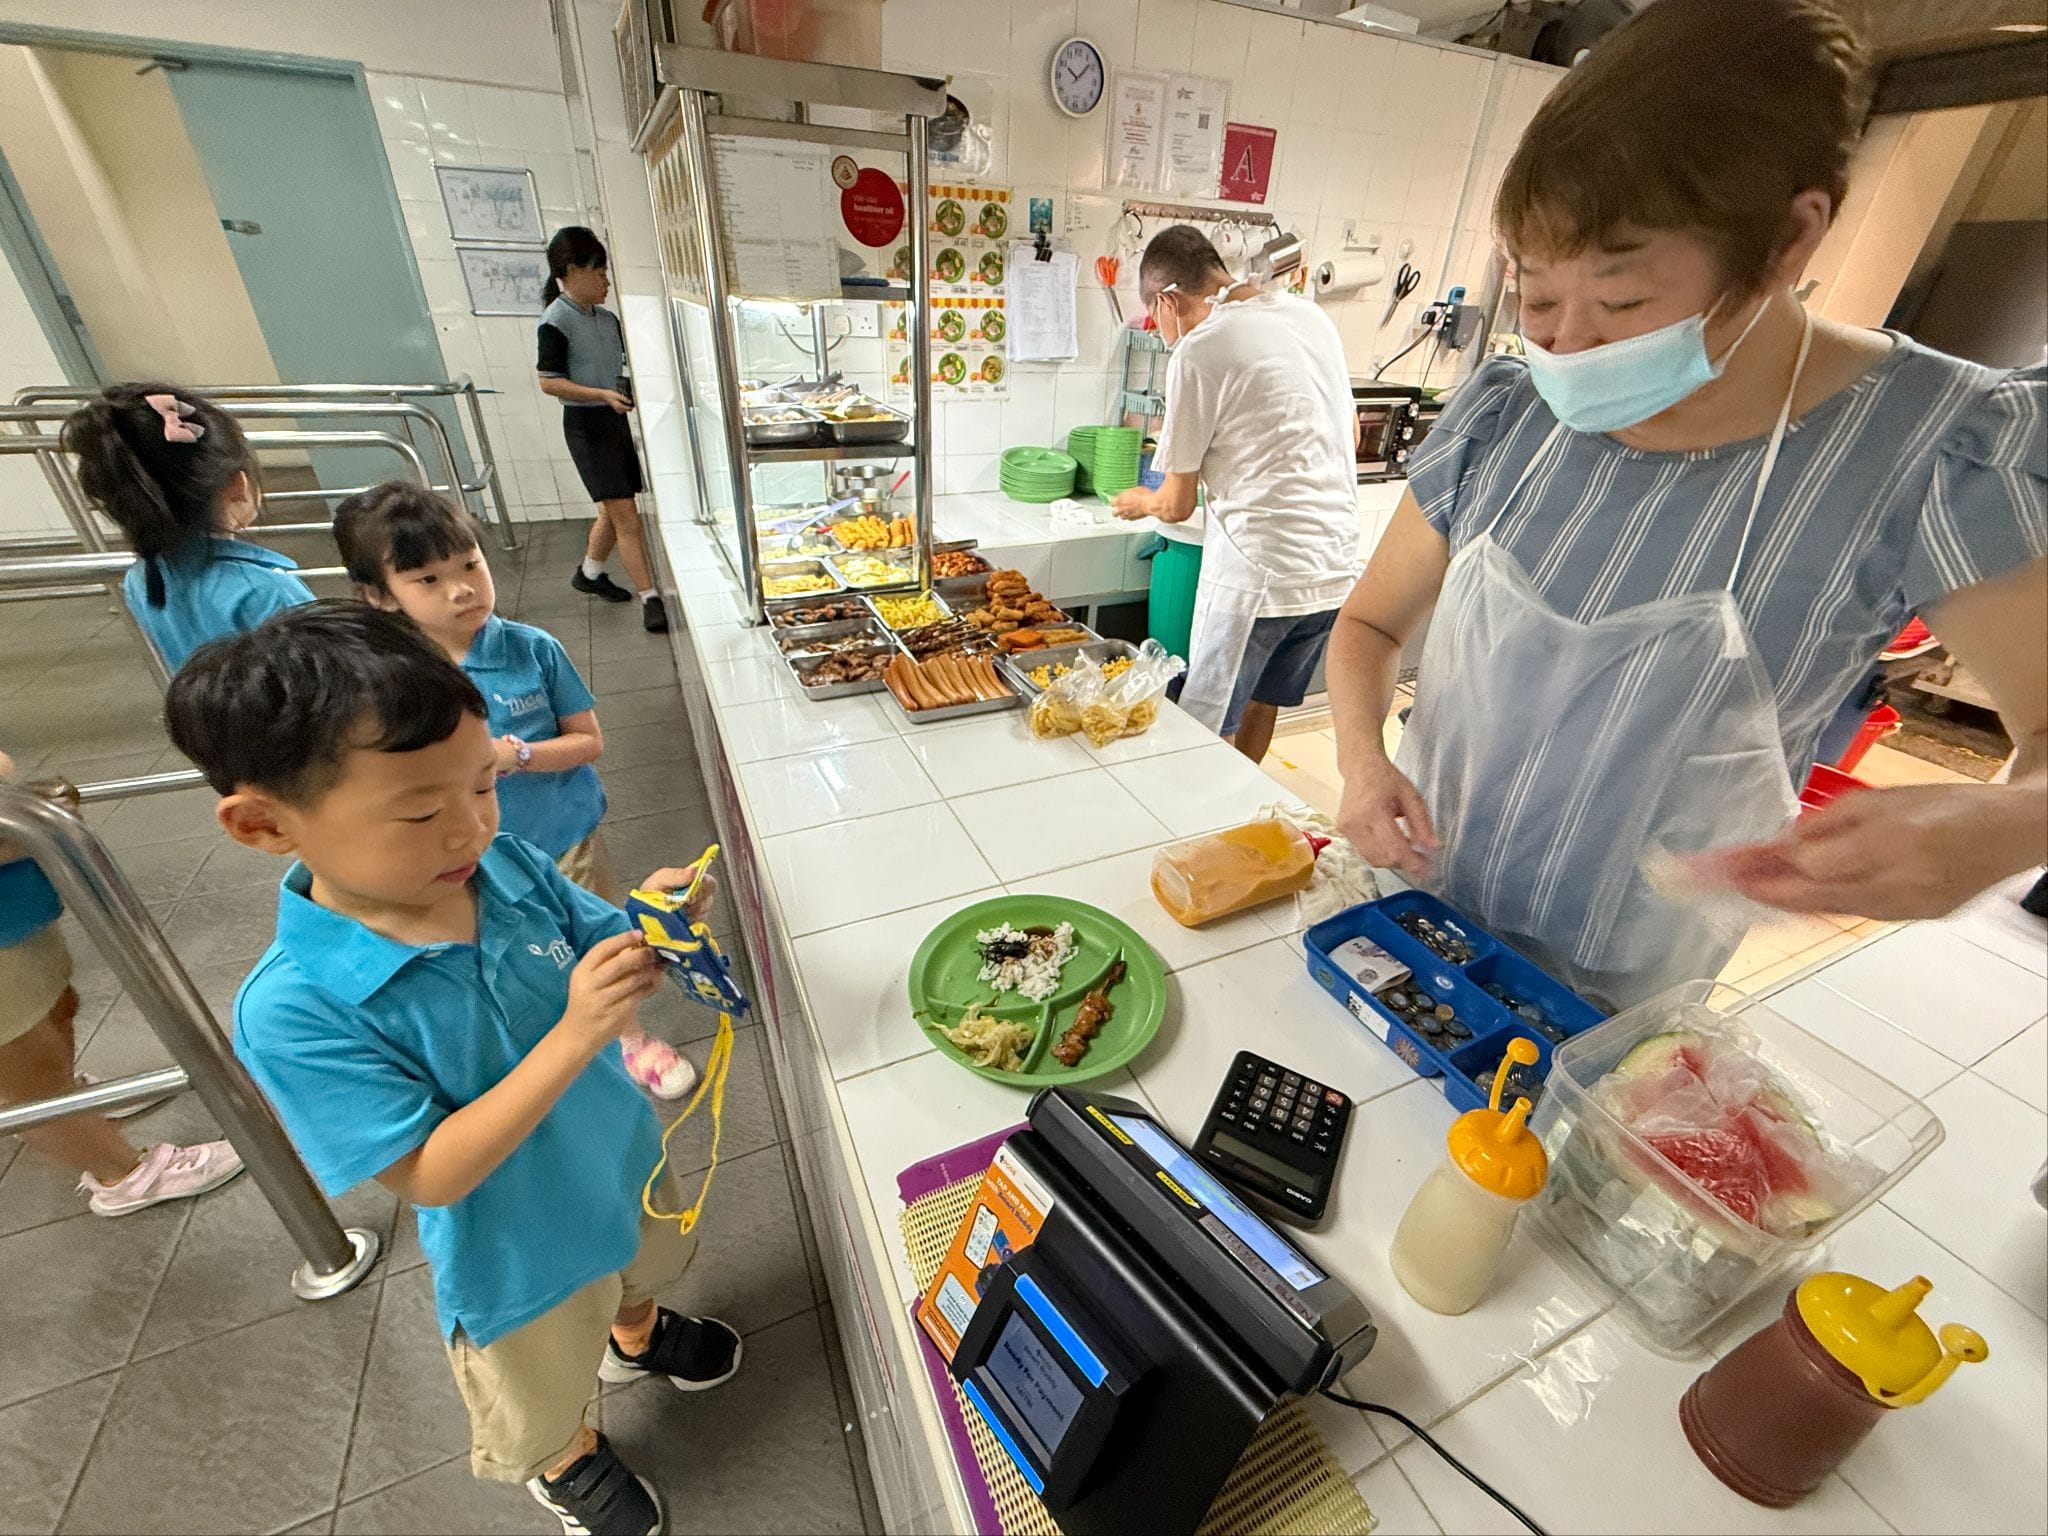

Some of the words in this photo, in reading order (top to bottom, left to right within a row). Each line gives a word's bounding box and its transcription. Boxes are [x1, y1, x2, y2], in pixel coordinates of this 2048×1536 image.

[1230, 143, 1256, 184] A
[853, 201, 884, 214] healthier
[1263, 1076, 1271, 1085] 3
[1259, 1087, 1268, 1096] 6
[1284, 1086, 1293, 1095] 2
[1309, 1084, 1317, 1093] 0
[1254, 1099, 1262, 1108] 9
[1280, 1097, 1289, 1107] 5
[1306, 1095, 1312, 1104] 1
[1275, 1108, 1284, 1118] 8
[1302, 1106, 1310, 1115] 4
[1221, 1111, 1235, 1120] OFF
[1297, 1119, 1305, 1128] 7
[997, 1177, 1008, 1191] TAP
[1007, 1190, 1020, 1206] AND
[1019, 1203, 1031, 1218] PAY
[1286, 1187, 1313, 1204] CASIO
[998, 1191, 1015, 1212] Smart
[1274, 1283, 1314, 1321] NETS
[1003, 1341, 1024, 1369] Ready
[1023, 1367, 1034, 1382] For
[1034, 1381, 1064, 1422] Payment
